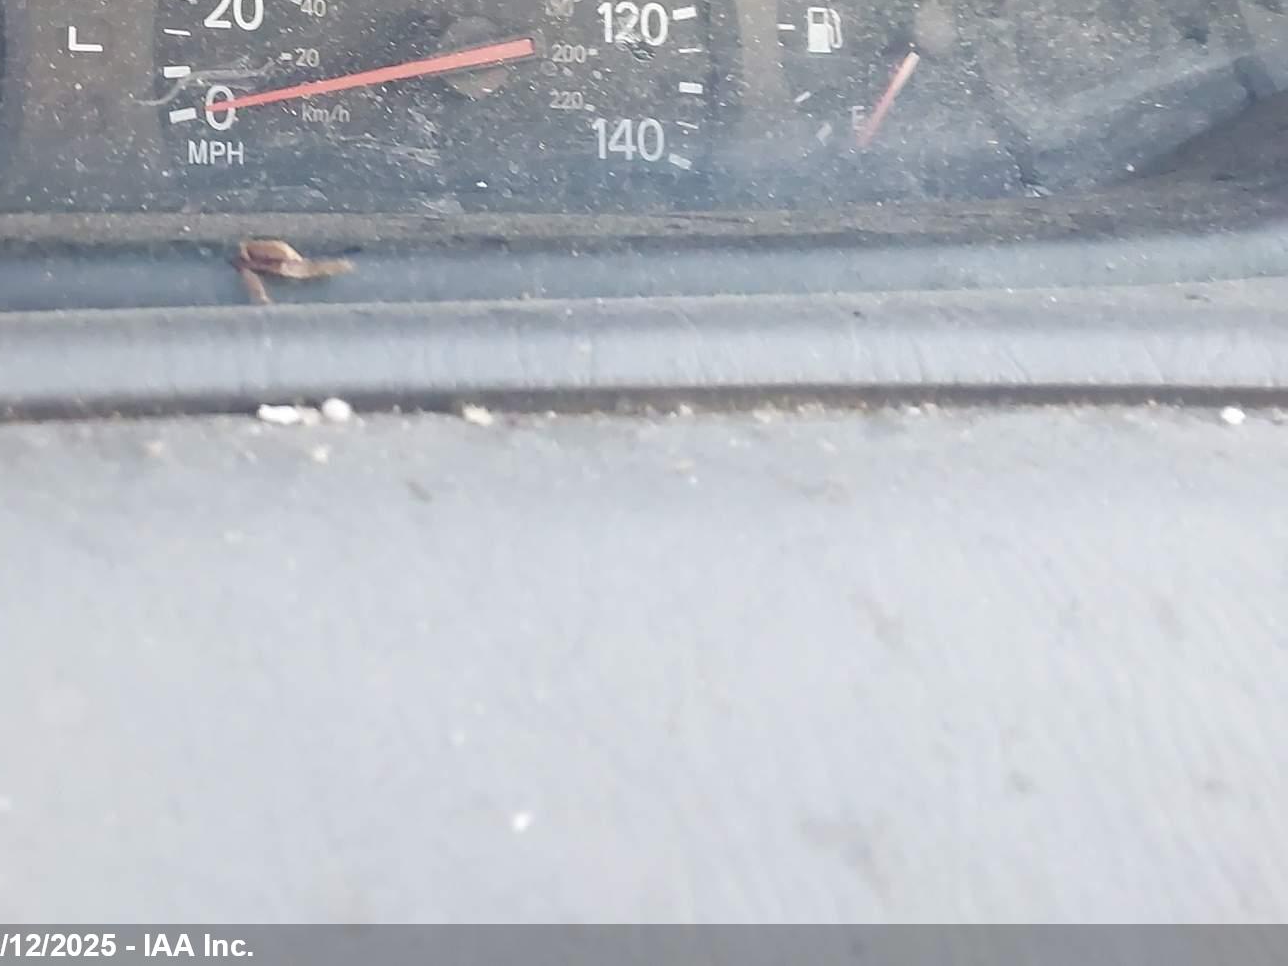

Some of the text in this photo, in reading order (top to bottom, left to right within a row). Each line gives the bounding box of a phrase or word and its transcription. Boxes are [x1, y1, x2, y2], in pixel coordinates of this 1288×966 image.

[300, 0, 327, 18] 40
[596, 1, 669, 46] 120
[68, 26, 103, 51] L
[294, 47, 320, 67] 20
[552, 44, 586, 63] 200
[204, 84, 236, 130] 0
[549, 89, 584, 110] 220
[590, 117, 665, 162] 140
[187, 140, 245, 166] MPH
